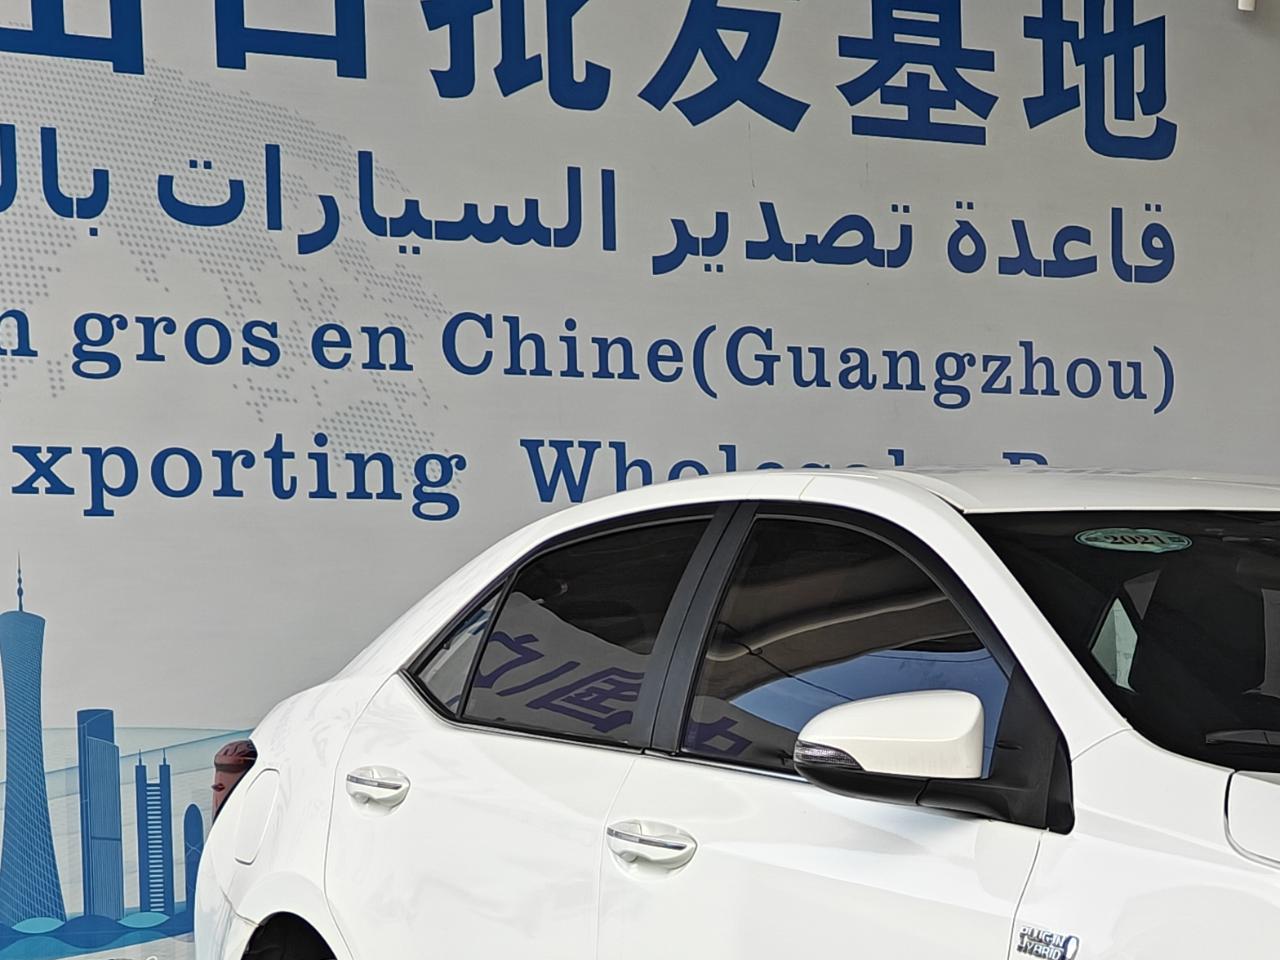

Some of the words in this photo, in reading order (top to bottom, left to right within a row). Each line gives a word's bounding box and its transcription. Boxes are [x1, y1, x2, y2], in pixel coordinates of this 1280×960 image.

[0, 0, 1178, 160] 批发基地
[157, 143, 617, 255] السيارات
[652, 200, 914, 276] تصدير
[946, 200, 1176, 284] قاعدة
[71, 311, 282, 379] gros
[311, 318, 414, 372] en
[11, 432, 467, 521] xporting
